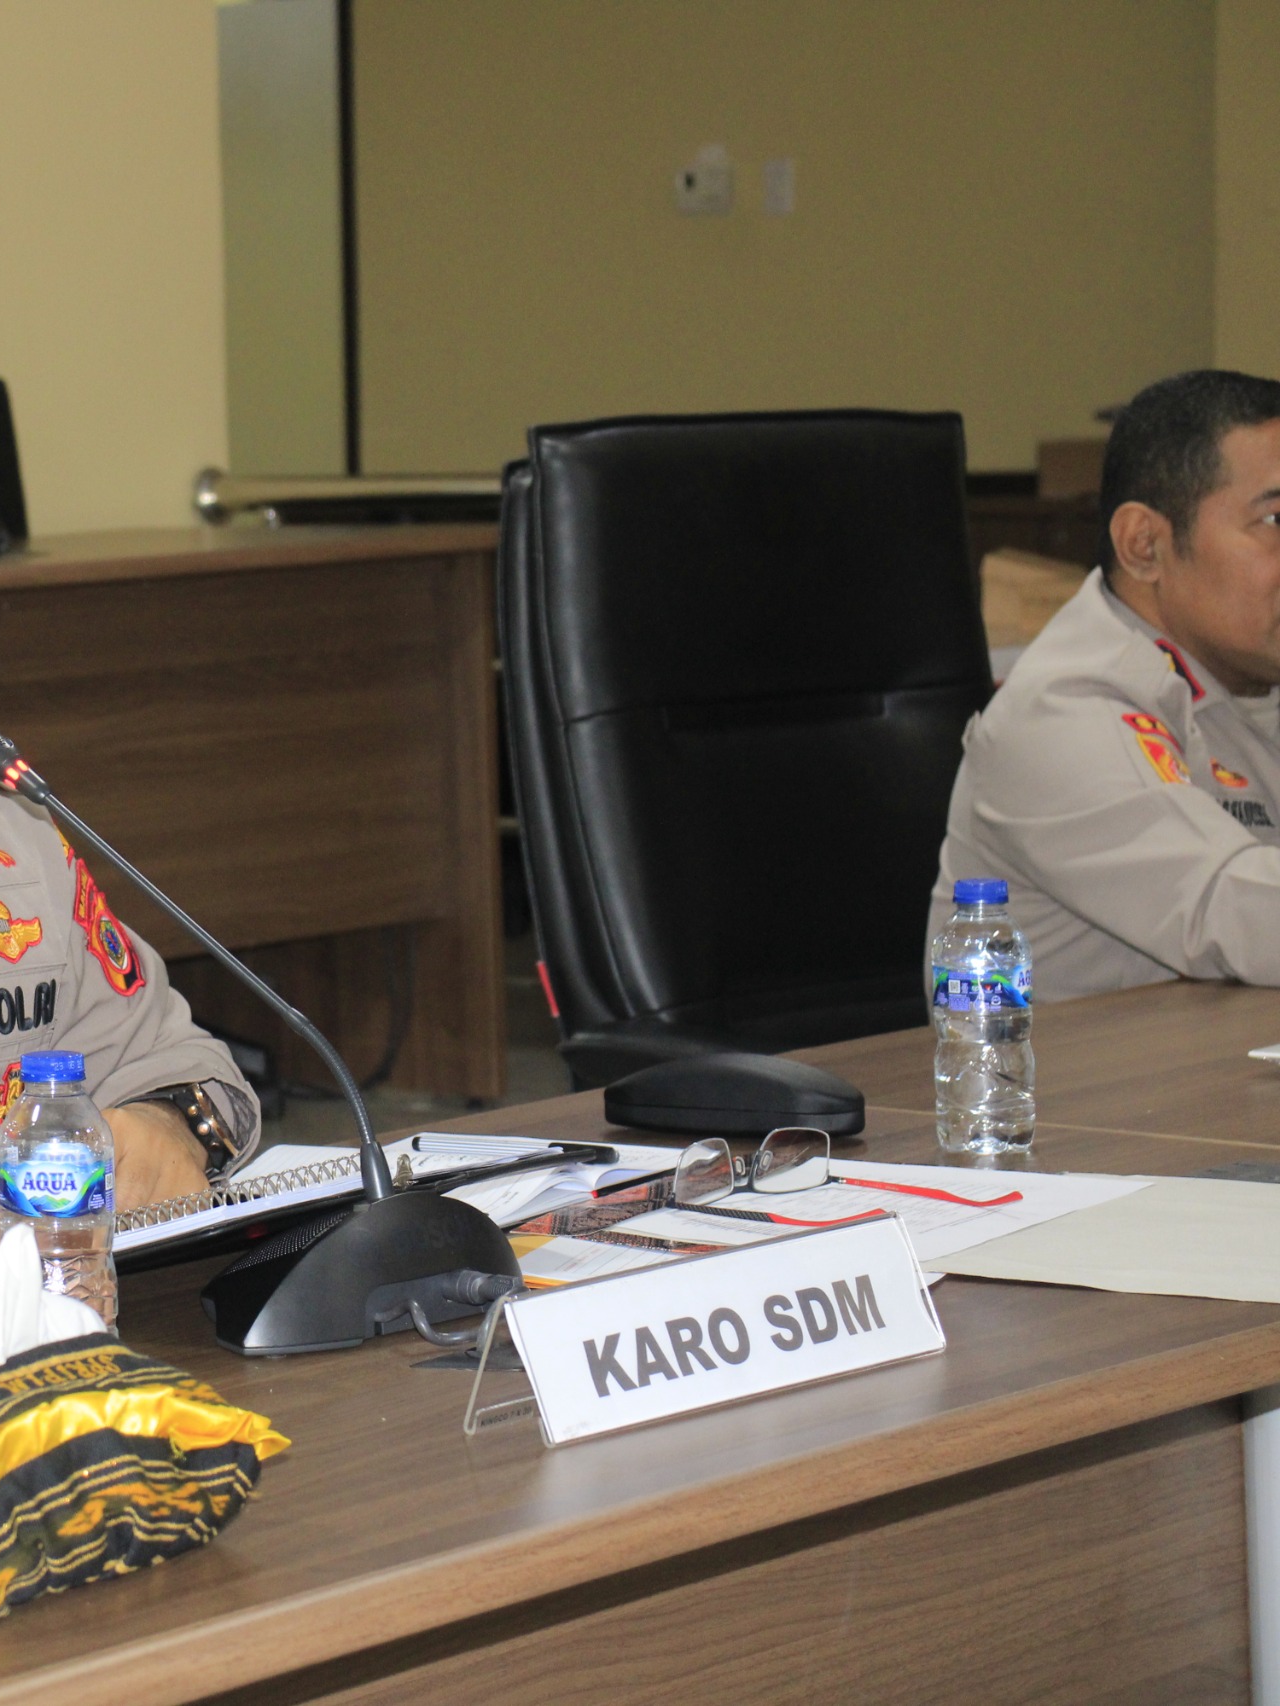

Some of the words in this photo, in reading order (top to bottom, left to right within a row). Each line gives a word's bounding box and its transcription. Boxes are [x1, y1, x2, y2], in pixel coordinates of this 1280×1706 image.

[21, 1171, 78, 1195] AQUA
[582, 1306, 751, 1398] KARO
[762, 1274, 887, 1352] SDM
